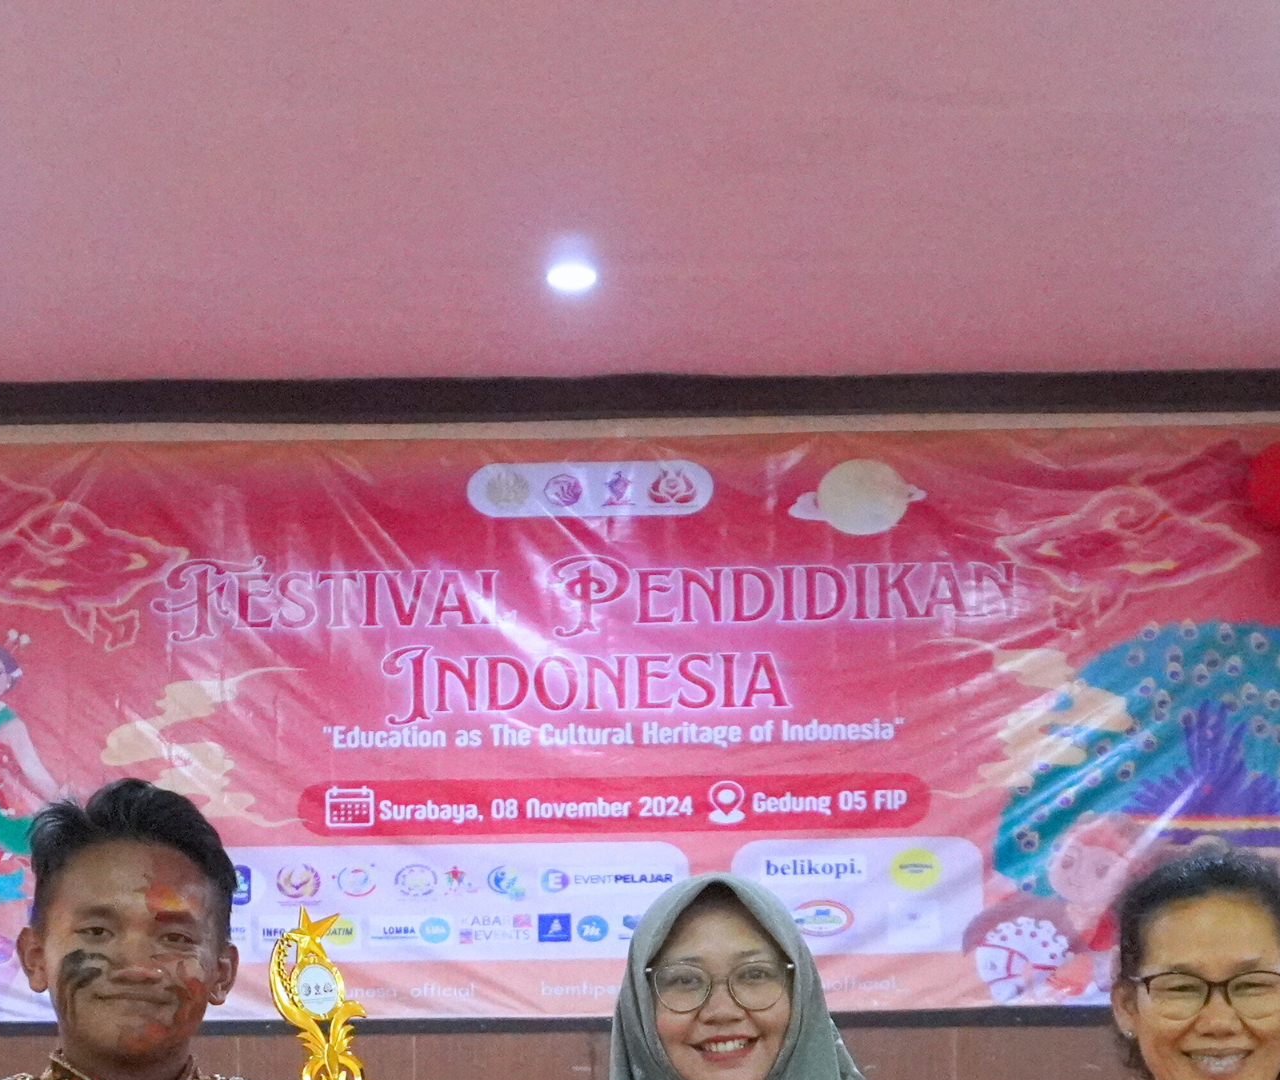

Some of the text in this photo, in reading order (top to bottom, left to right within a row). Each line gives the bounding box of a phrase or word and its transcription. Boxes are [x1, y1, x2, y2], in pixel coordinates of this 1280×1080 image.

[150, 555, 1018, 643] FESTIVAL PENDIDIKAN
[381, 645, 792, 726] INDONESIA
[455, 728, 482, 747] as
[490, 723, 531, 746] The
[538, 722, 633, 746] Cultural
[642, 721, 741, 748] Heritage
[750, 719, 774, 742] of
[380, 795, 693, 824] Surabaya, 08 November 2024
[752, 789, 907, 815] Gedung 05 FIP
[765, 858, 862, 879] belikopi.
[383, 926, 416, 935] LOMBA
